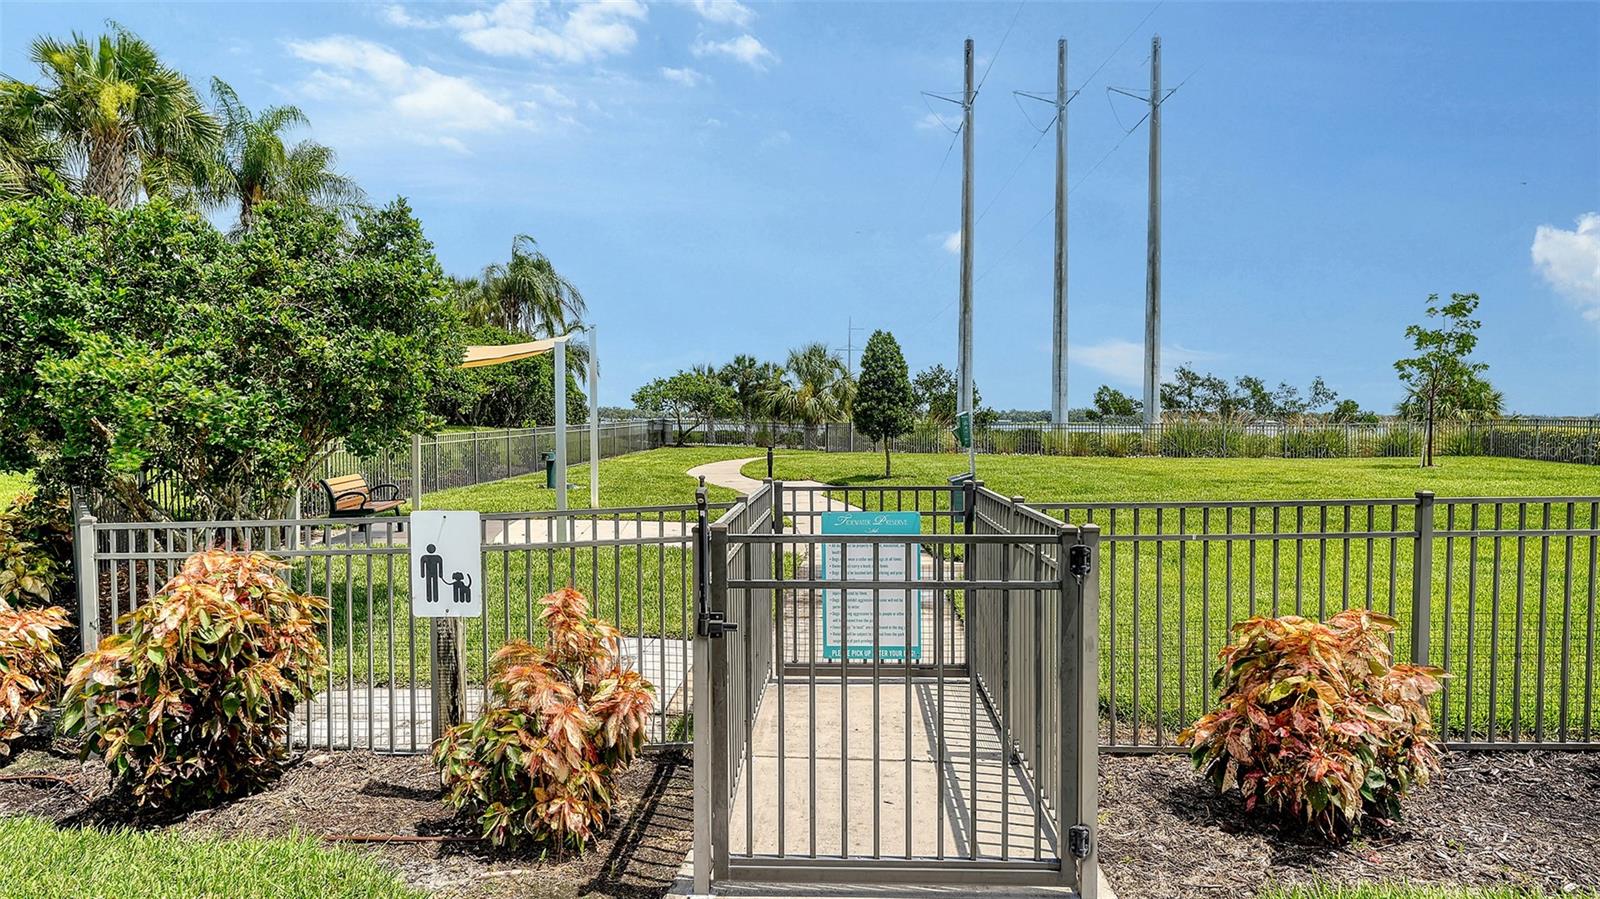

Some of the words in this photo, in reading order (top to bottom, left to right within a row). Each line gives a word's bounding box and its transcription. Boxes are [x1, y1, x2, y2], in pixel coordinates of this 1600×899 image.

[851, 649, 863, 657] PICK
[863, 649, 871, 657] UP
[889, 649, 903, 658] YOUR
